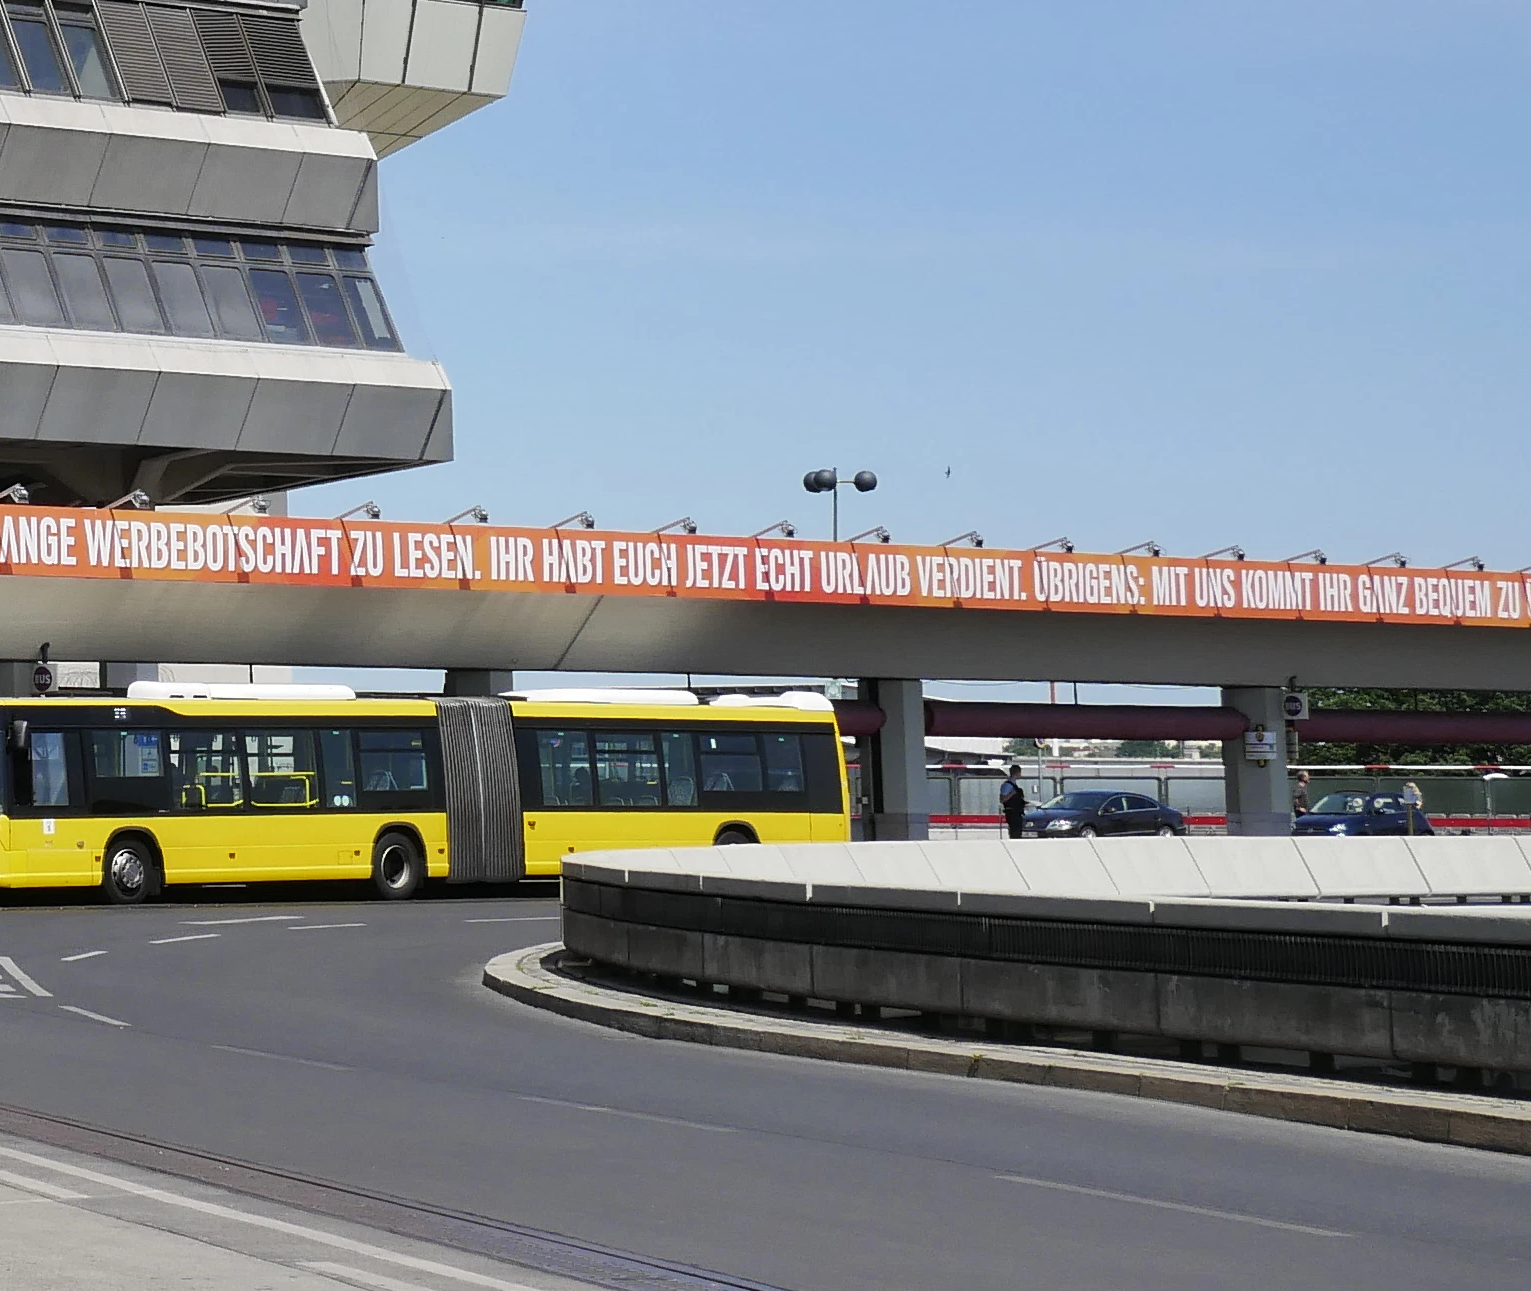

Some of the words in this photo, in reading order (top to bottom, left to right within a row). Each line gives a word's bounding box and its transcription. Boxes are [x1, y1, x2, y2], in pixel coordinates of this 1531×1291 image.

[84, 518, 343, 576] WERBEBOTSCHAFT
[349, 530, 384, 577] ZU
[393, 531, 482, 580] LESEN.
[489, 535, 533, 583] IHR
[542, 537, 606, 586] HABT
[613, 540, 677, 587] EUCH
[686, 543, 748, 590] JETZT
[755, 547, 814, 593] ECHT
[820, 550, 912, 597] URLAUB
[916, 554, 1026, 601] VERDIENT.
[1033, 555, 1146, 606] ÜBRIGENS:
[1152, 565, 1188, 608] MIT
[1194, 567, 1236, 609] UNS
[1241, 569, 1314, 611] KOMMT
[1318, 572, 1353, 612] IHR
[1357, 573, 1410, 615] GANZ
[1414, 577, 1491, 618] BEQUEM
[1497, 581, 1520, 620] ZU
